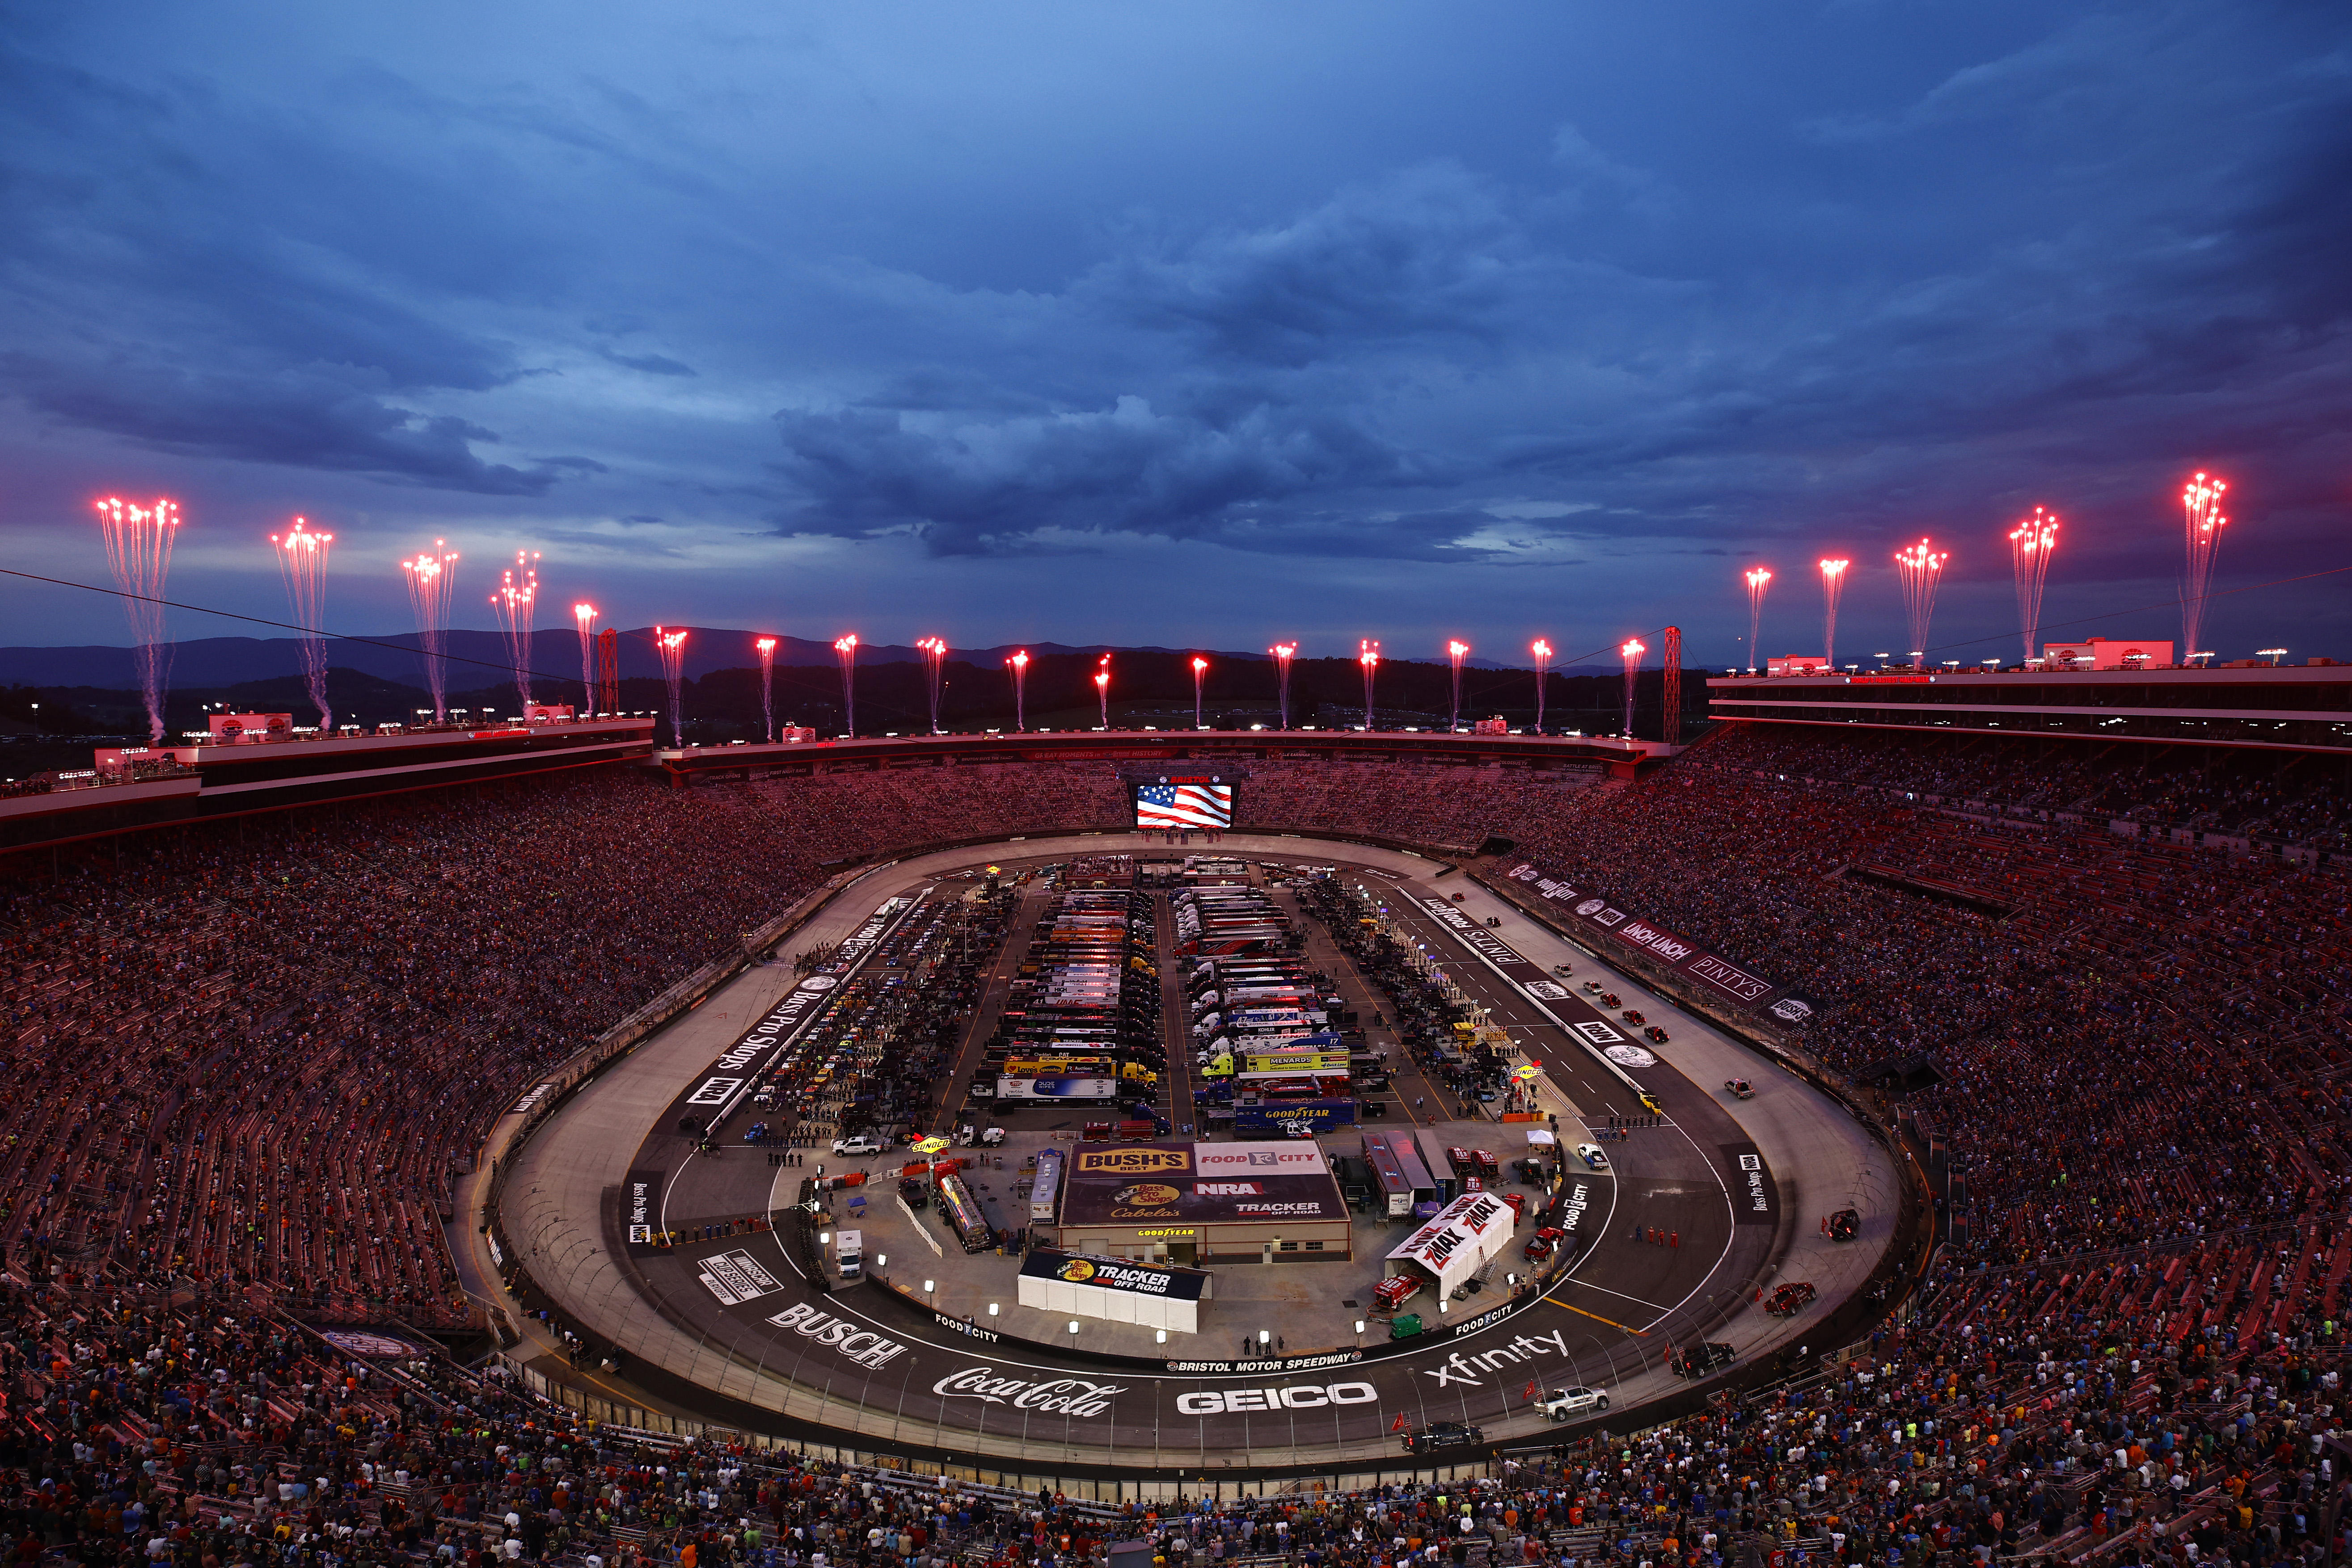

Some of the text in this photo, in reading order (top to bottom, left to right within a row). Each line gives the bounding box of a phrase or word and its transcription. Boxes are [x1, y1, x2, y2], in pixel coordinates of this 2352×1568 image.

[1535, 878, 1557, 891] FOOD
[1423, 899, 1447, 909] CITY
[1443, 915, 1473, 928] FOOD
[1598, 910, 1622, 923] NRA
[857, 923, 885, 938] FOOD
[1623, 923, 1660, 944] UNOH
[1464, 932, 1519, 962] PINTY'S
[1651, 936, 1692, 960] UNOH
[1695, 959, 1764, 996] PINTY'S
[1529, 982, 1563, 999] BUSH'S
[1774, 1000, 1809, 1020] BUSH'S
[718, 991, 823, 1070] Bass Pro Shops
[1582, 1023, 1618, 1042] NRA
[694, 1079, 737, 1101] NRA
[914, 1140, 949, 1151] SUNOCO
[1085, 1154, 1182, 1168] BUSH'S
[1743, 1156, 1757, 1169] NRA
[1197, 1184, 1258, 1195] NRA
[1748, 1172, 1768, 1211] Bass Pro Shops
[630, 1183, 647, 1223] Bass Pro Shops
[1111, 1208, 1180, 1218] Cabela's
[1236, 1202, 1319, 1211] TRACKER
[1562, 1209, 1581, 1231] FOOD
[1572, 1184, 1588, 1201] CITY
[713, 1261, 753, 1293] CUP SERIES
[739, 1262, 774, 1287] NASCAR
[1069, 1271, 1088, 1279] Shops
[1097, 1265, 1171, 1286] TRACKER
[1387, 1280, 1399, 1289] DRYING
[1552, 1269, 1564, 1283] UNOH
[705, 1279, 730, 1299] PLAYOFFS
[1113, 1280, 1166, 1293] OFF ROAD
[935, 1313, 998, 1343] FOOD CITY
[1456, 1303, 1512, 1336] FOOD CITY
[765, 1302, 908, 1370] BUSCH
[1178, 1353, 1351, 1372] BRISTOL MOTOR SPEEDWAY
[1423, 1329, 1569, 1388] xfinity
[933, 1367, 1129, 1417] Coca-Cola
[1176, 1382, 1378, 1415] GEICO
